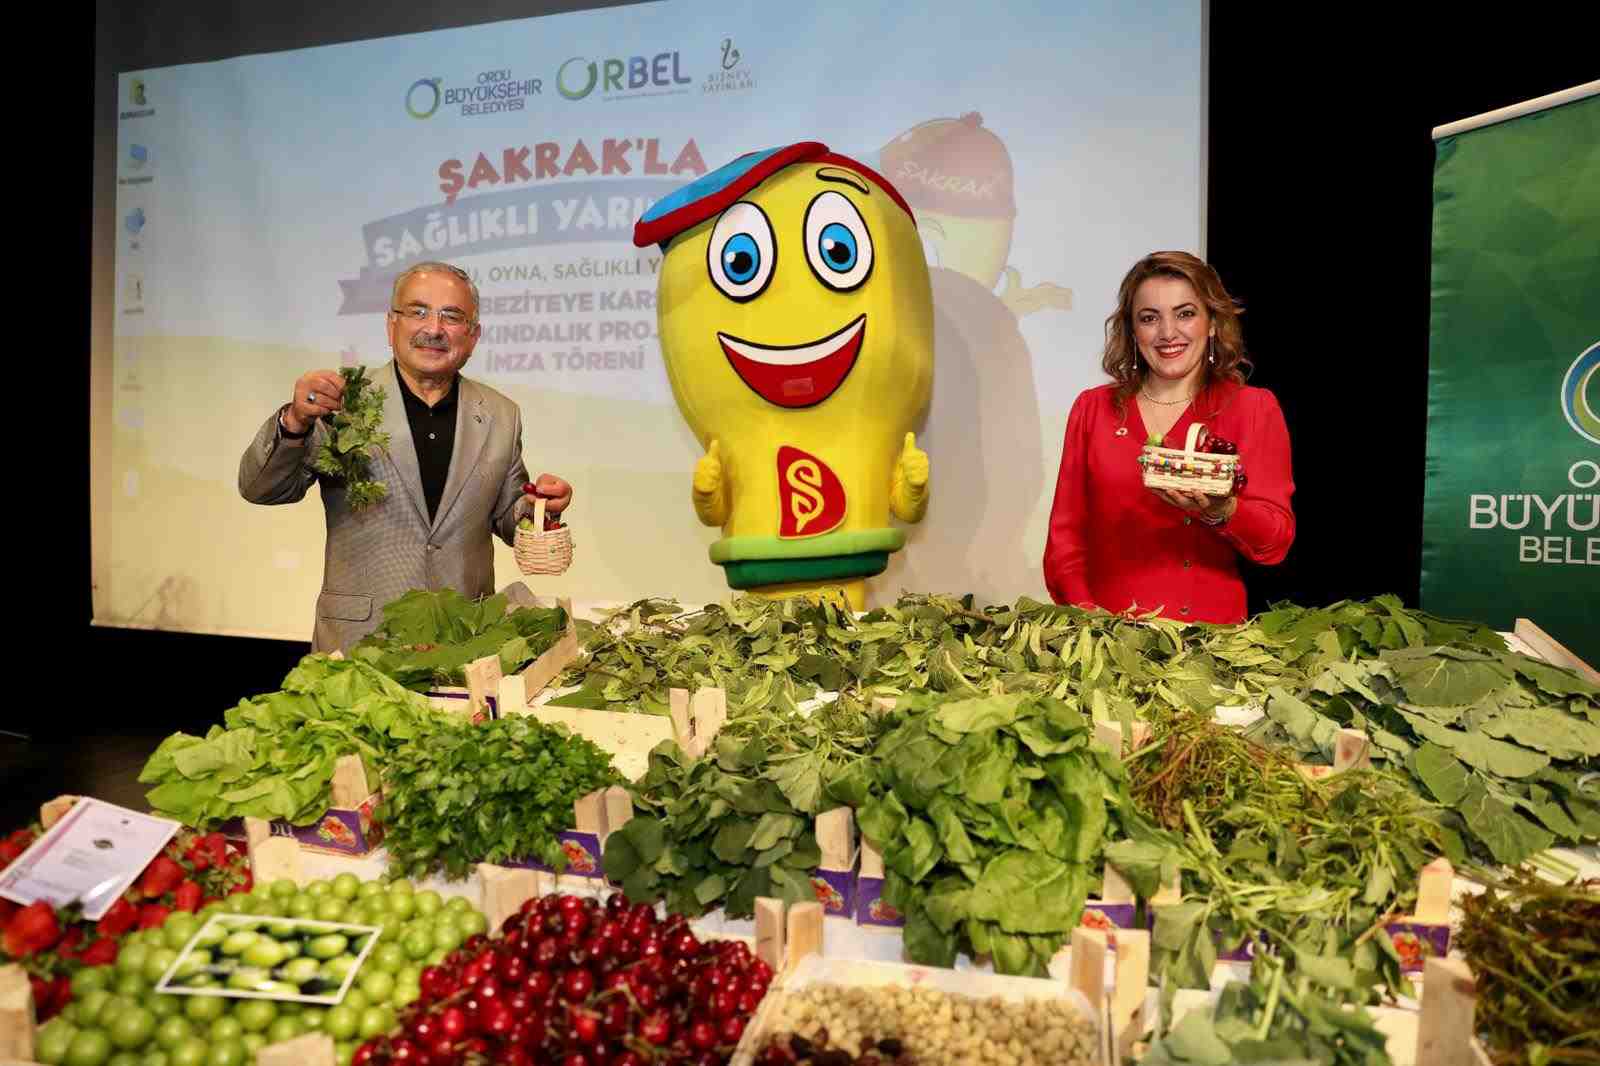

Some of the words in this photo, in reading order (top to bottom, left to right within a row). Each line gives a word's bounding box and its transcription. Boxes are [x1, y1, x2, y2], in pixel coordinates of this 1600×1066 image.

[438, 137, 707, 207] ŞAKRAK'LA
[372, 202, 540, 269] SAĞLIKLI
[551, 195, 656, 231] YARI
[488, 264, 548, 283] OYNA,
[553, 257, 641, 281] SAĞLIKLI
[648, 257, 662, 275] Y
[480, 290, 594, 316] BEZİTEYE
[481, 322, 593, 344] KINDALIK
[486, 350, 545, 372] İMZA
[552, 346, 646, 371] TÖRENİ
[1469, 493, 1600, 531] BÜYÜ
[1519, 535, 1600, 565] BELE
